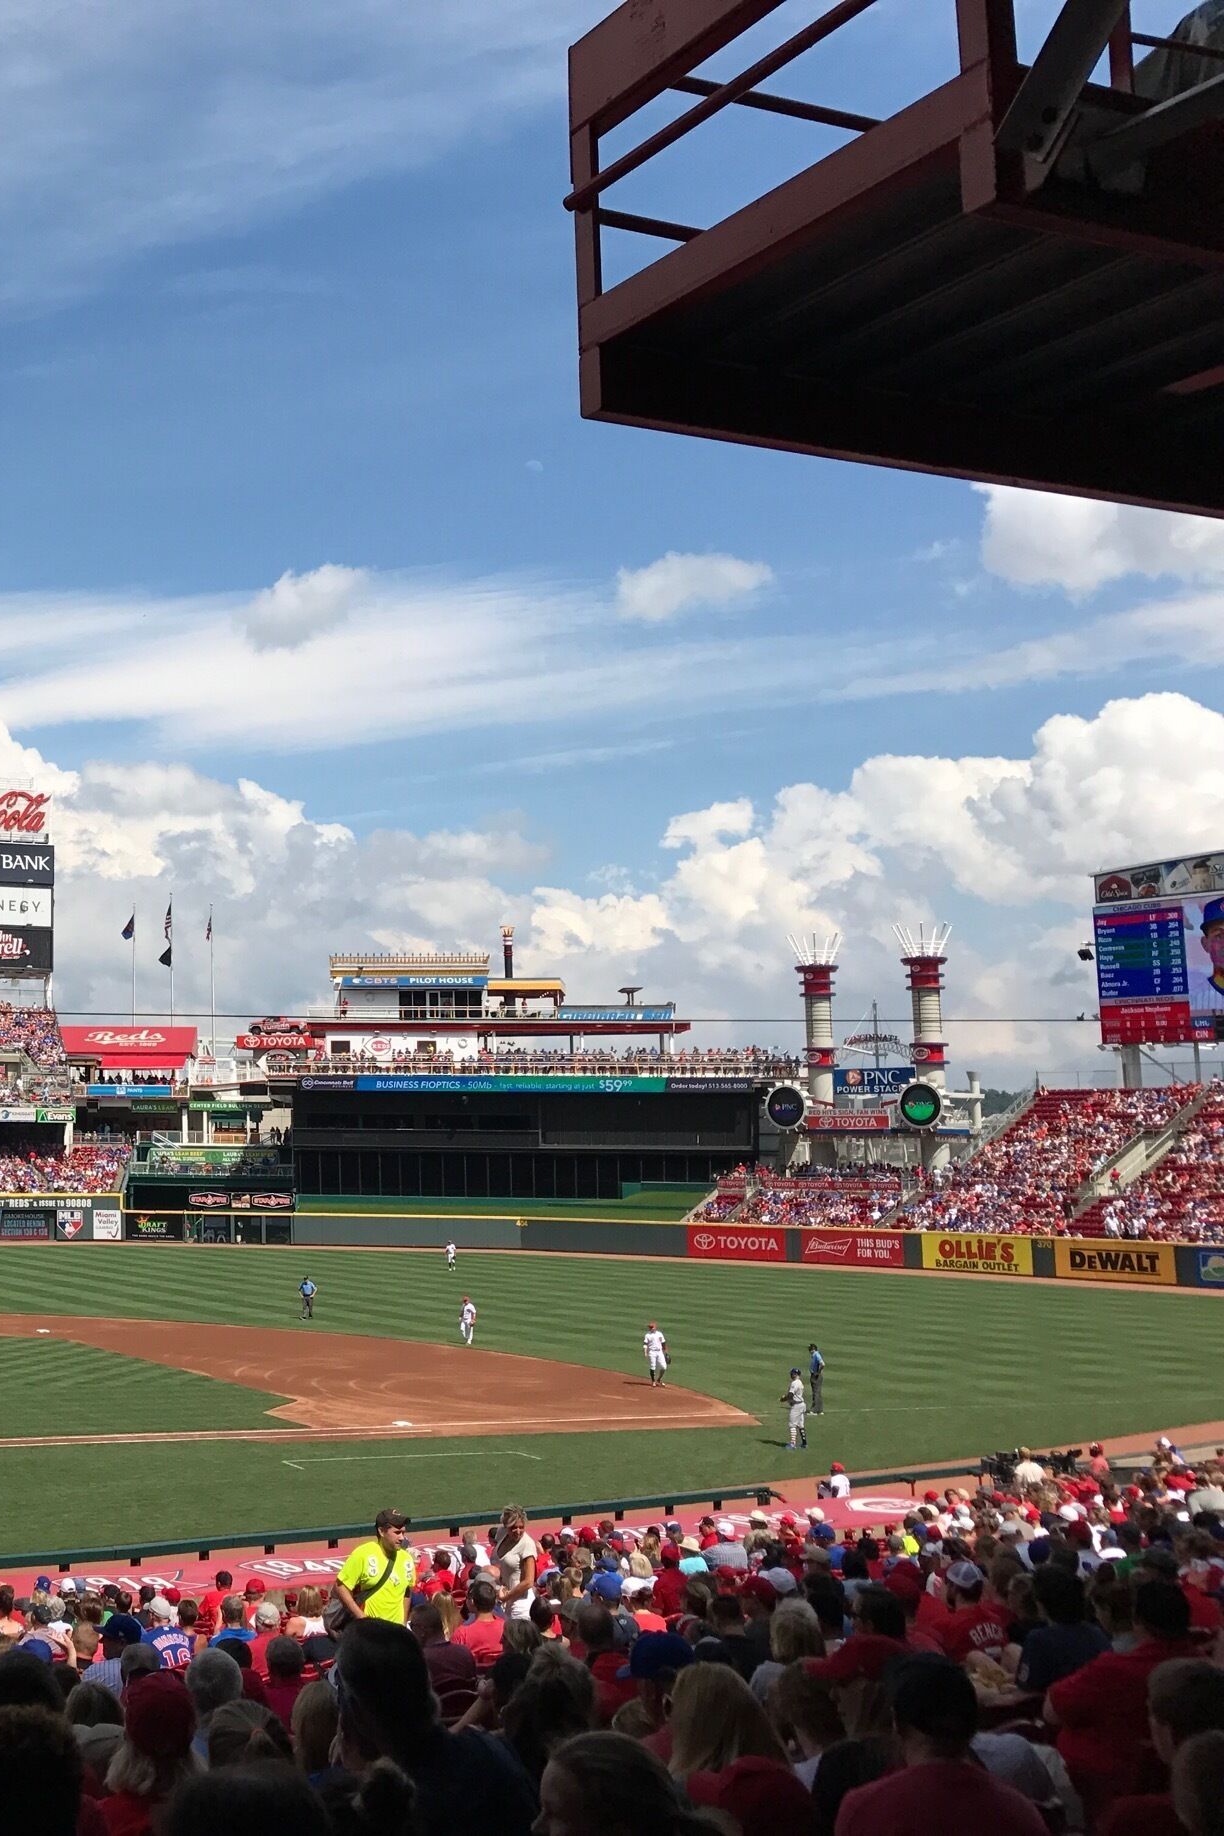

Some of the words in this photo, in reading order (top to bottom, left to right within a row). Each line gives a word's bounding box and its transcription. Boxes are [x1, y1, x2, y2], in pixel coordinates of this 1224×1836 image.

[1, 854, 50, 871] BANK
[1112, 904, 1142, 912] CHICAGO
[84, 1030, 167, 1045] Reds
[1195, 1031, 1209, 1039] CIN
[261, 1037, 307, 1046] TOYOTA
[864, 1070, 901, 1085] PNC
[376, 1080, 419, 1089] BUSINESS
[420, 1080, 461, 1089] FIOPTICS
[467, 1081, 492, 1089] 50Mb
[545, 1082, 573, 1091] starting
[688, 1082, 708, 1090] today!
[836, 1086, 871, 1094] POWER
[781, 1103, 797, 1111] PNC
[47, 1111, 73, 1121] Evans
[835, 1117, 877, 1127] TOYOTA
[39, 1200, 57, 1208] ISSUE
[65, 1199, 92, 1208] 90808
[58, 1211, 82, 1220] MLB
[97, 1218, 119, 1227] Valley
[139, 1221, 167, 1229] DRAFT
[142, 1226, 167, 1234] KINGS
[717, 1236, 779, 1251] TOYOTA
[810, 1239, 848, 1251] Budweiser
[856, 1238, 874, 1248] THIS
[875, 1239, 900, 1249] BUD'S
[1036, 1240, 1053, 1249] 370
[857, 1248, 874, 1259] FOR
[874, 1249, 893, 1260] YOU.
[935, 1258, 979, 1271] BARGAIN
[982, 1260, 1020, 1273] OUTLET
